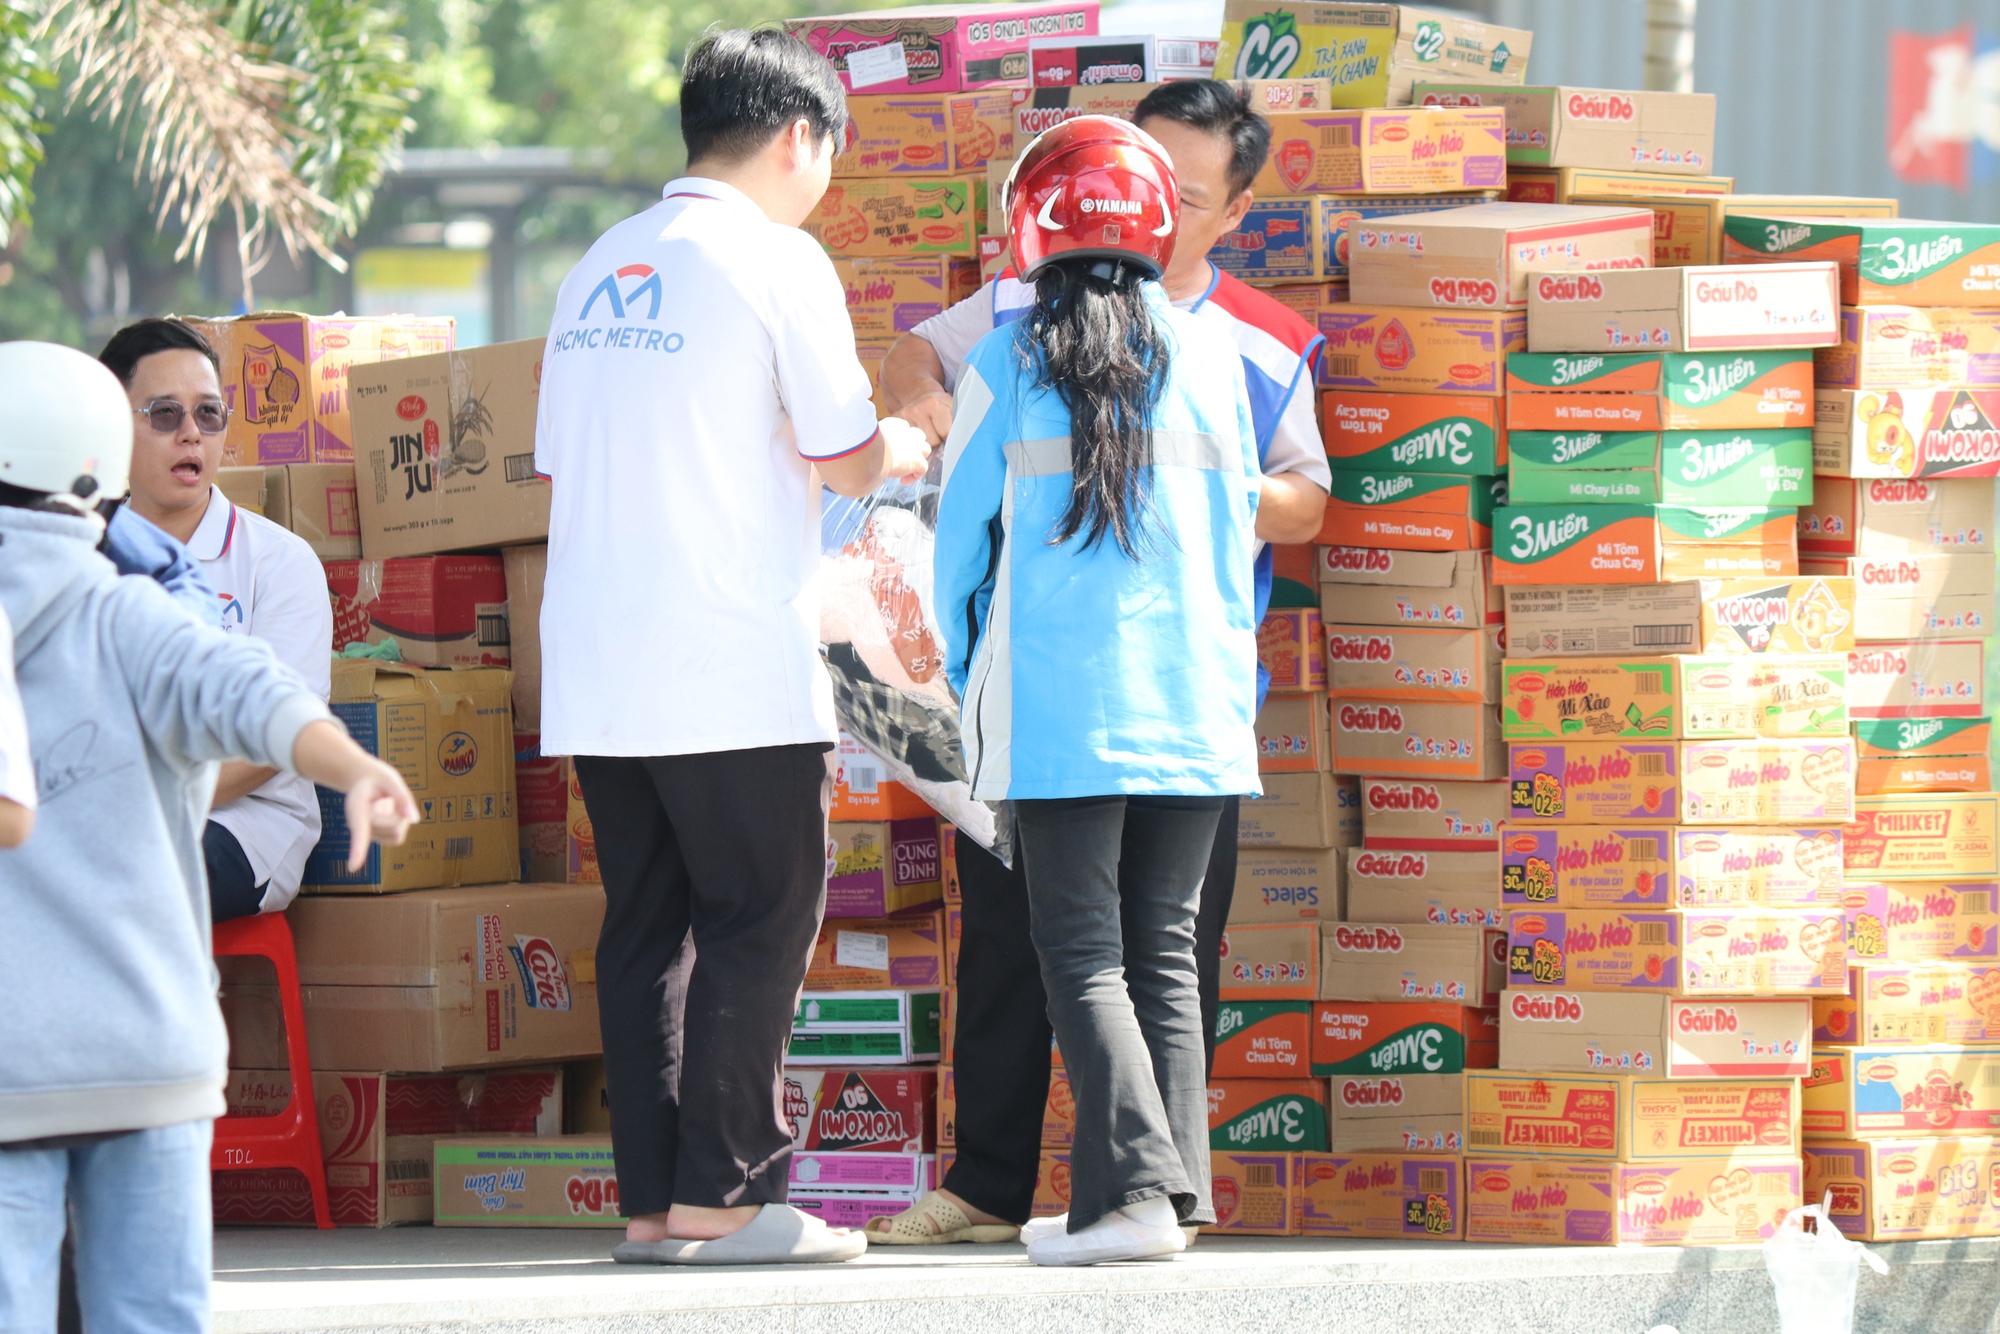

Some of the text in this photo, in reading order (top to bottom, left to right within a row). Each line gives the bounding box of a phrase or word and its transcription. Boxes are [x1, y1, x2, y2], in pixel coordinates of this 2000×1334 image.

[1029, 14, 1061, 35] NGON
[1060, 12, 1085, 32] DAI
[1237, 23, 1298, 79] C2
[1316, 38, 1368, 65] TRÀ XANH
[1413, 25, 1446, 60] C2
[1493, 51, 1509, 62] UP
[1002, 59, 1026, 78] PRO
[1088, 64, 1143, 84] Omachi
[1340, 56, 1379, 85] CHANH
[1095, 199, 1142, 215] YAMAHA
[554, 326, 685, 354] HCMC METRO
[250, 362, 266, 376] 10
[320, 384, 340, 416] MÌ
[1556, 407, 1642, 421] Mì Tôm Chua Cay
[390, 432, 423, 471] JIN
[404, 463, 432, 500] JU
[1570, 482, 1640, 498] Mì Chay Lá Đa
[1783, 479, 1798, 491] Đa
[408, 521, 419, 529] 303
[1364, 522, 1453, 539] Mì Tôm Chua Cay
[1598, 543, 1639, 556] Mì Tôm
[1590, 557, 1644, 571] Chua Cay
[1397, 603, 1463, 622] Tôm và Gà
[1716, 598, 1788, 626] KOKOMI
[1395, 668, 1471, 686] Gà Sợi Phở
[1547, 676, 1588, 700] Hảo Hảo
[1558, 693, 1611, 718] Mì Xào
[1282, 735, 1308, 753] Phở
[1405, 738, 1472, 759] Gà Sợi Phở
[444, 749, 474, 771] PANKO
[1564, 749, 1631, 788] Hảo Hảo
[1534, 793, 1552, 814] 02
[1878, 814, 1942, 832] MILIKET
[895, 844, 937, 861] CUNG
[1556, 834, 1623, 872] Hảo Hảo
[898, 862, 936, 880] ĐÌNH
[1262, 886, 1319, 905] Select
[1526, 878, 1544, 899] 02
[1428, 908, 1447, 924] Gà
[1450, 908, 1472, 926] Sợi
[1564, 917, 1632, 955] Hảo Hảo
[524, 939, 558, 1009] Care
[1233, 963, 1307, 984] Gà Sợi Phở
[1534, 960, 1552, 980] 02
[1401, 979, 1465, 998] Tôm và Gà
[1252, 1038, 1291, 1050] Mì Tôm
[1246, 1051, 1298, 1065] Chua Cay
[1587, 1049, 1652, 1069] Tôm và Gà
[843, 1086, 868, 1108] 90
[820, 1109, 903, 1141] KOKOMI
[1510, 1124, 1580, 1144] MILIKET
[1687, 1125, 1752, 1143] MILIKET
[1939, 1160, 1978, 1196] BIG
[1512, 1182, 1567, 1212] Hảo Hảo
